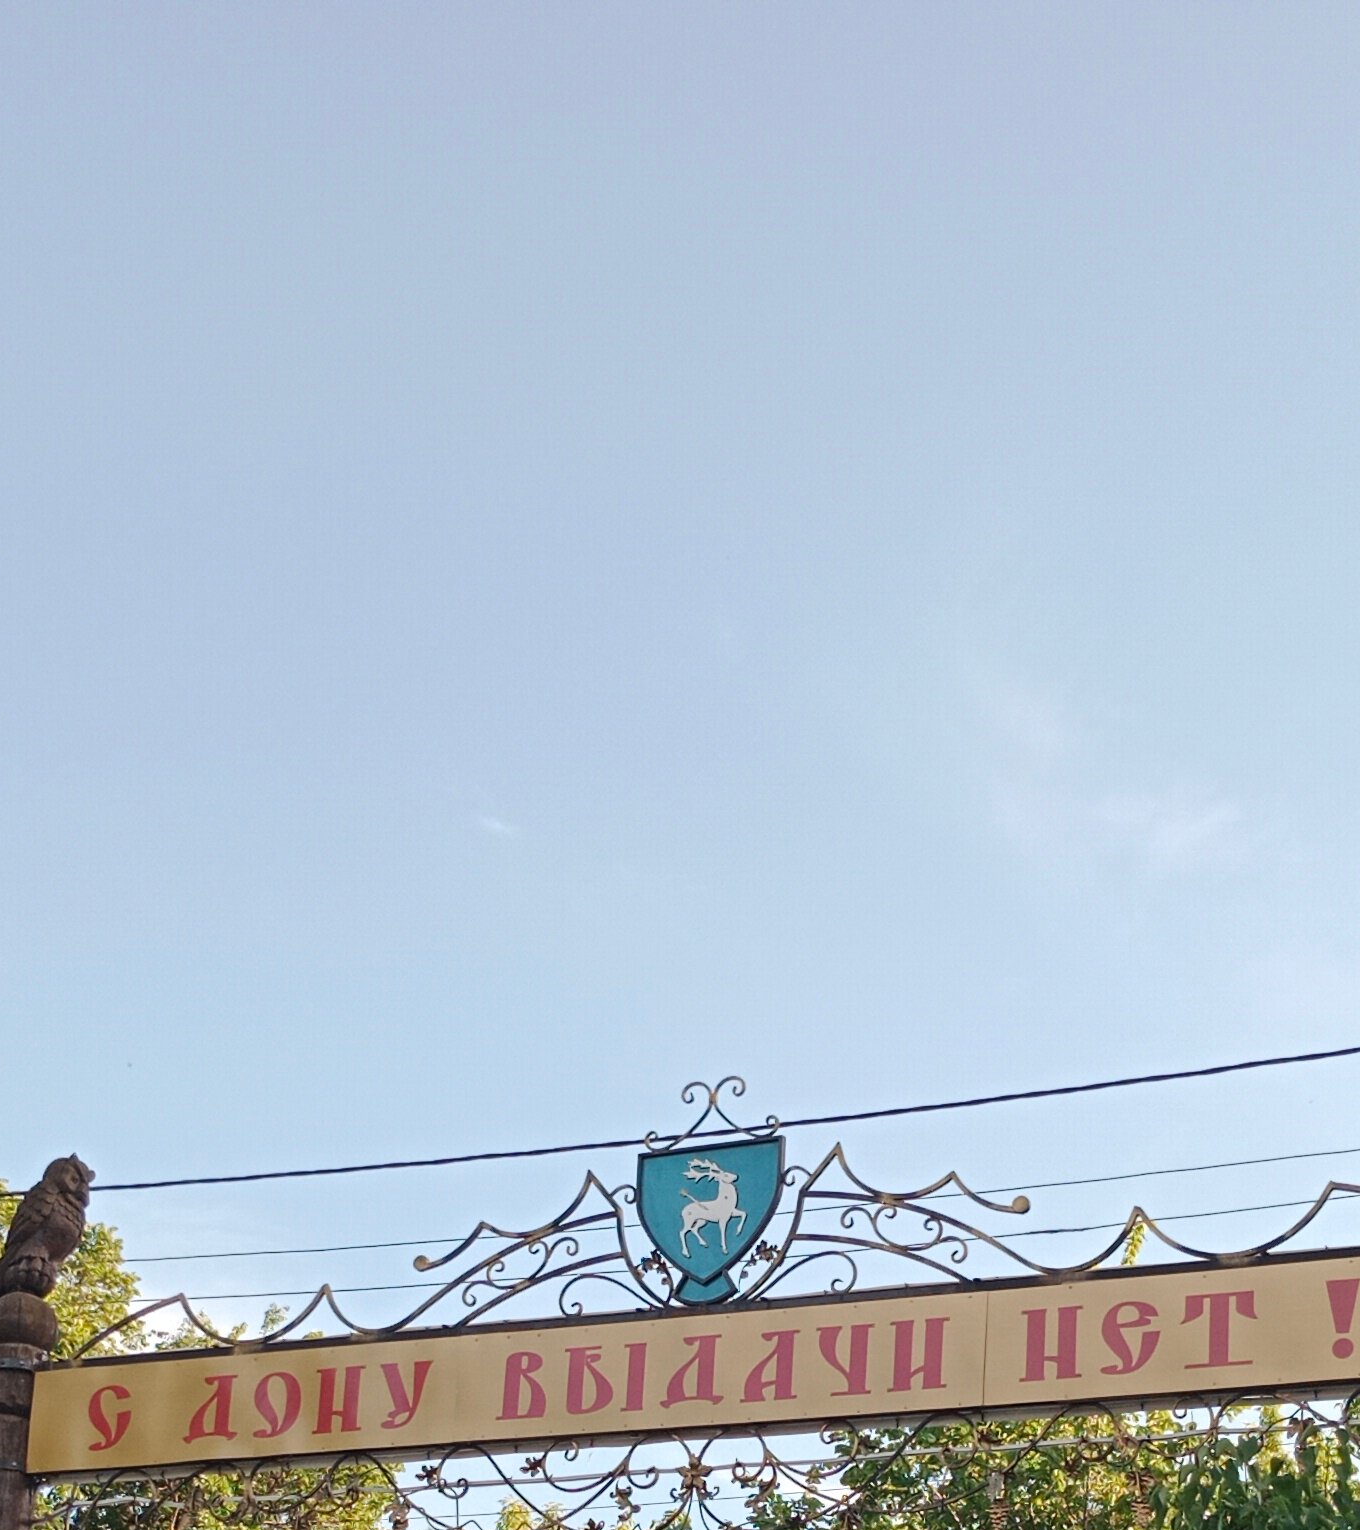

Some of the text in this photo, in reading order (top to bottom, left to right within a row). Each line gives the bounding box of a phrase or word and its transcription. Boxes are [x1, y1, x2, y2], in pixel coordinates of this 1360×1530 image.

[87, 1278, 1360, 1452] С ДОНУ ВЫДАЧИ НЕТ !
